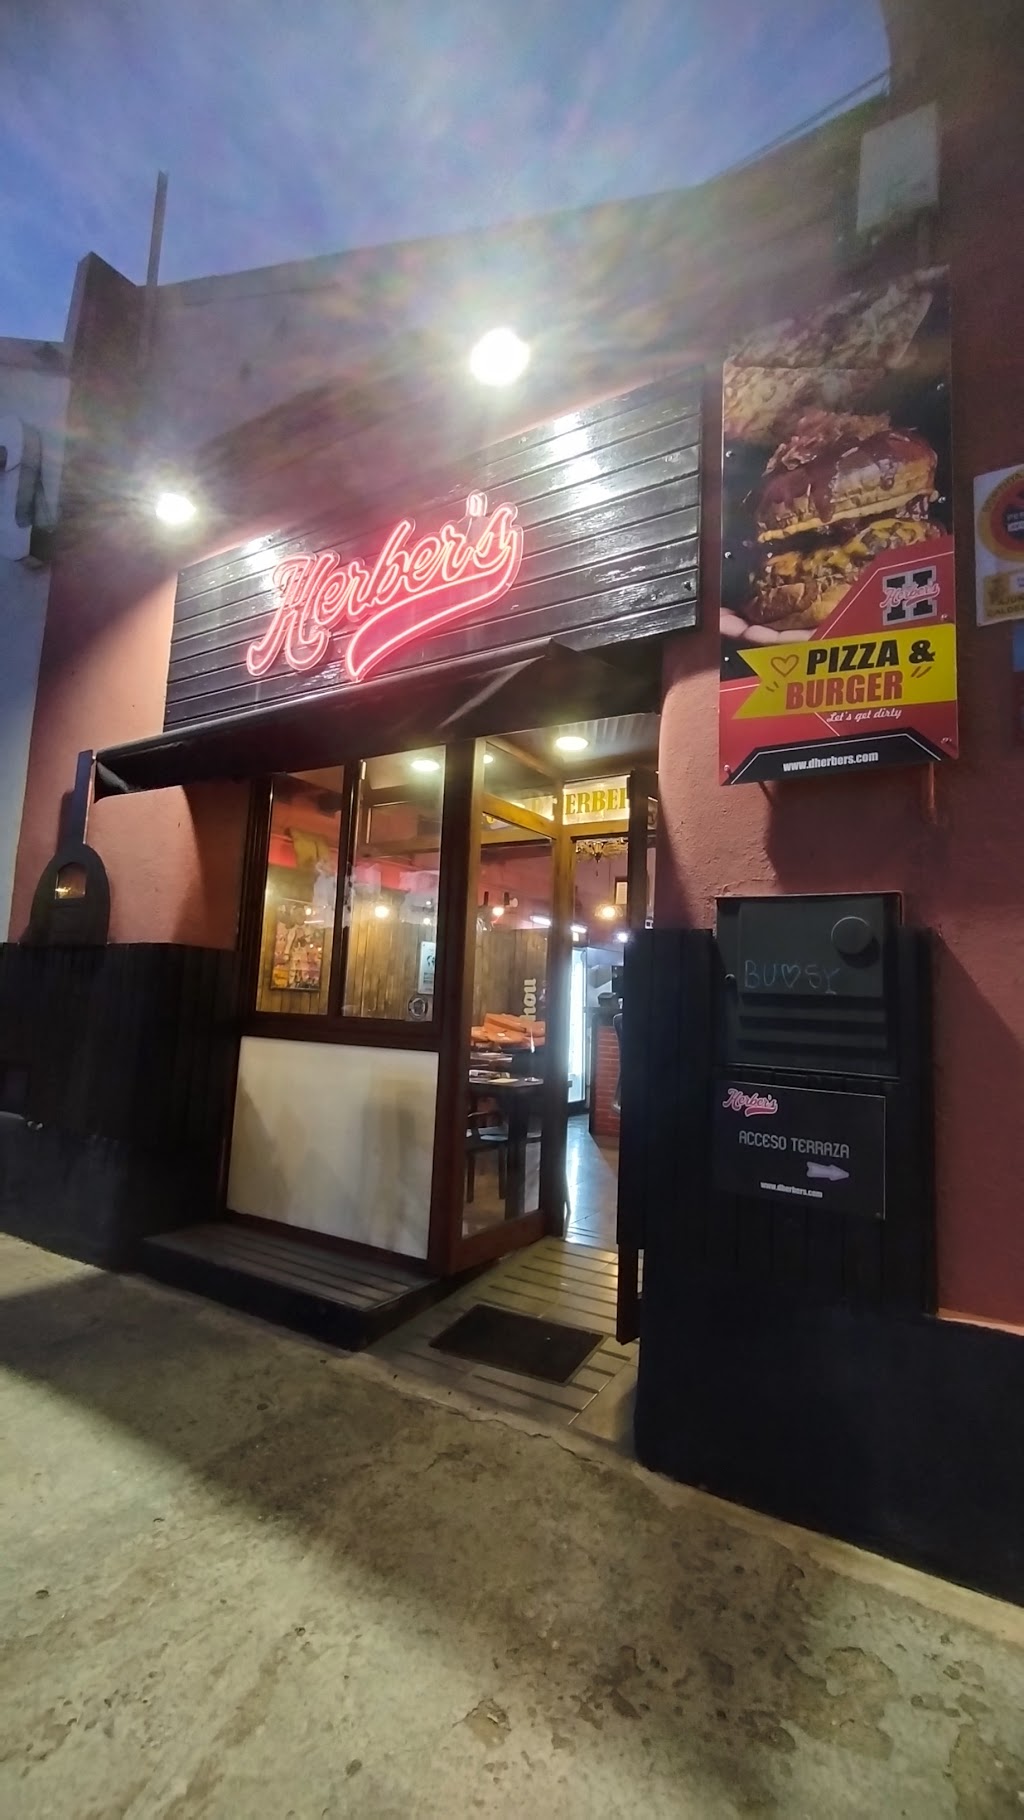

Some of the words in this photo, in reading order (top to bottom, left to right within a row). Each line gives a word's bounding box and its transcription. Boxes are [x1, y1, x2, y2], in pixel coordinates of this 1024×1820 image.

[247, 489, 523, 681] Herber's
[806, 640, 899, 675] PIZZA
[908, 640, 935, 664] &
[786, 670, 903, 710] BURGER
[827, 711, 852, 723] Let's
[855, 709, 872, 722] get
[874, 707, 902, 719] dirty
[783, 752, 879, 772] www.dherbers.com
[722, 1088, 778, 1117] Herber's
[738, 1130, 787, 1151] ACCESO
[790, 1137, 849, 1159] TERRAZA
